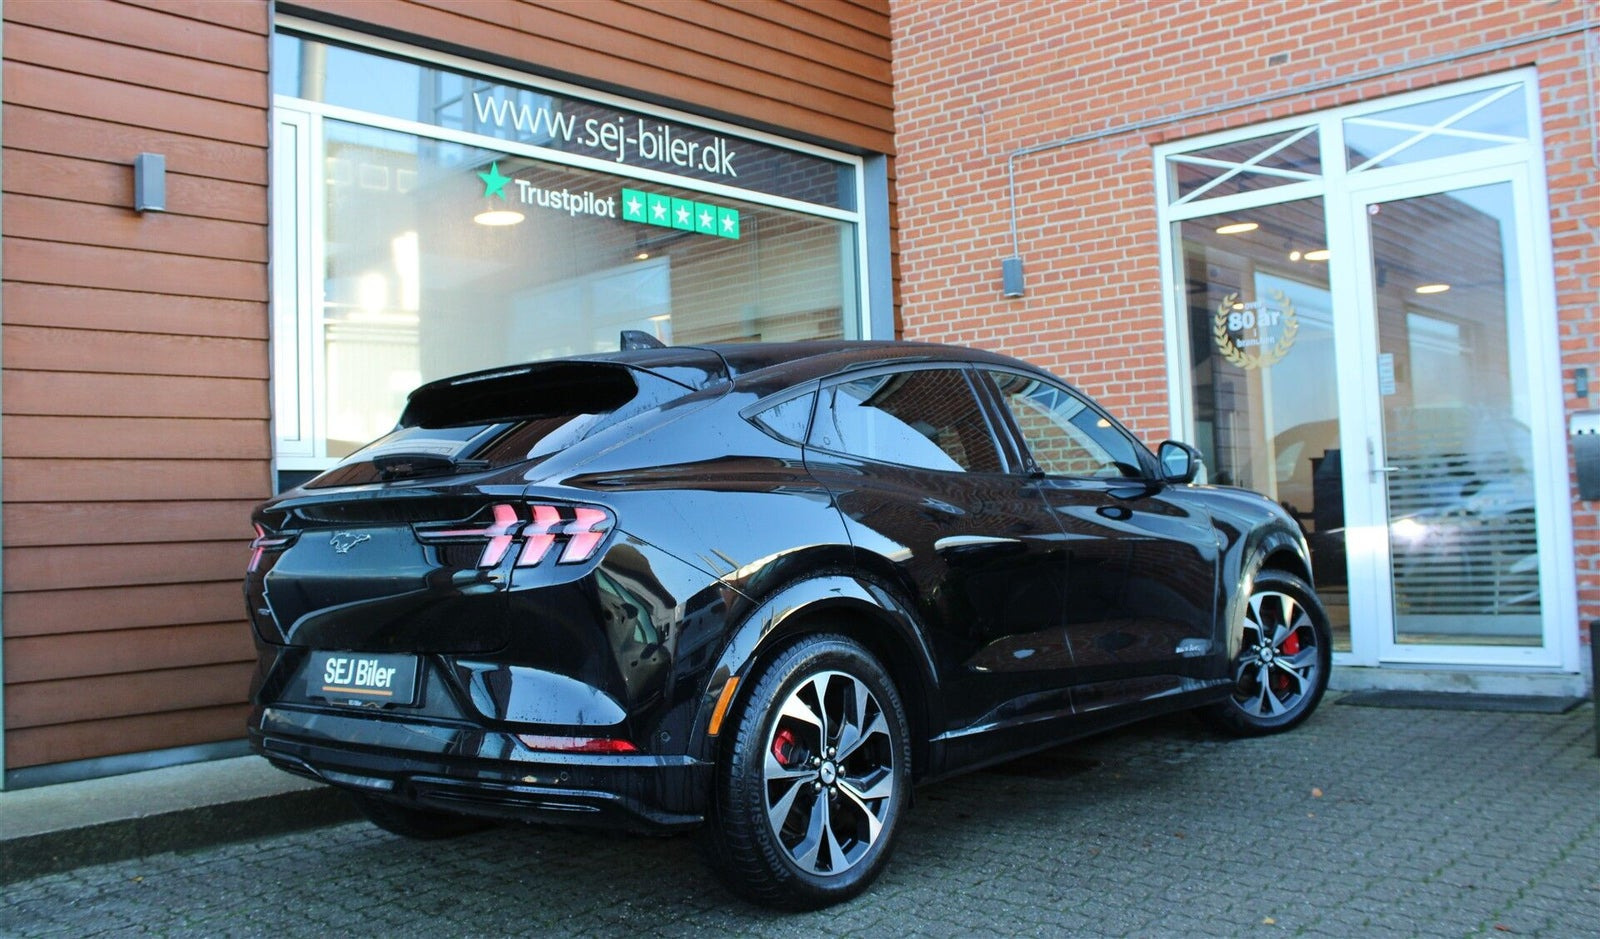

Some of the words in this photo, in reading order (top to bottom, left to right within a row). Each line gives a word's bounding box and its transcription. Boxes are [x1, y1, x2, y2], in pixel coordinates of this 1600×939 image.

[473, 92, 737, 177] www.sej-biler.dk
[515, 179, 615, 218] Trustpilot
[1228, 312, 1255, 331] 80
[1258, 307, 1280, 326] år
[324, 657, 354, 684] SEJ
[355, 660, 396, 688] Biler
